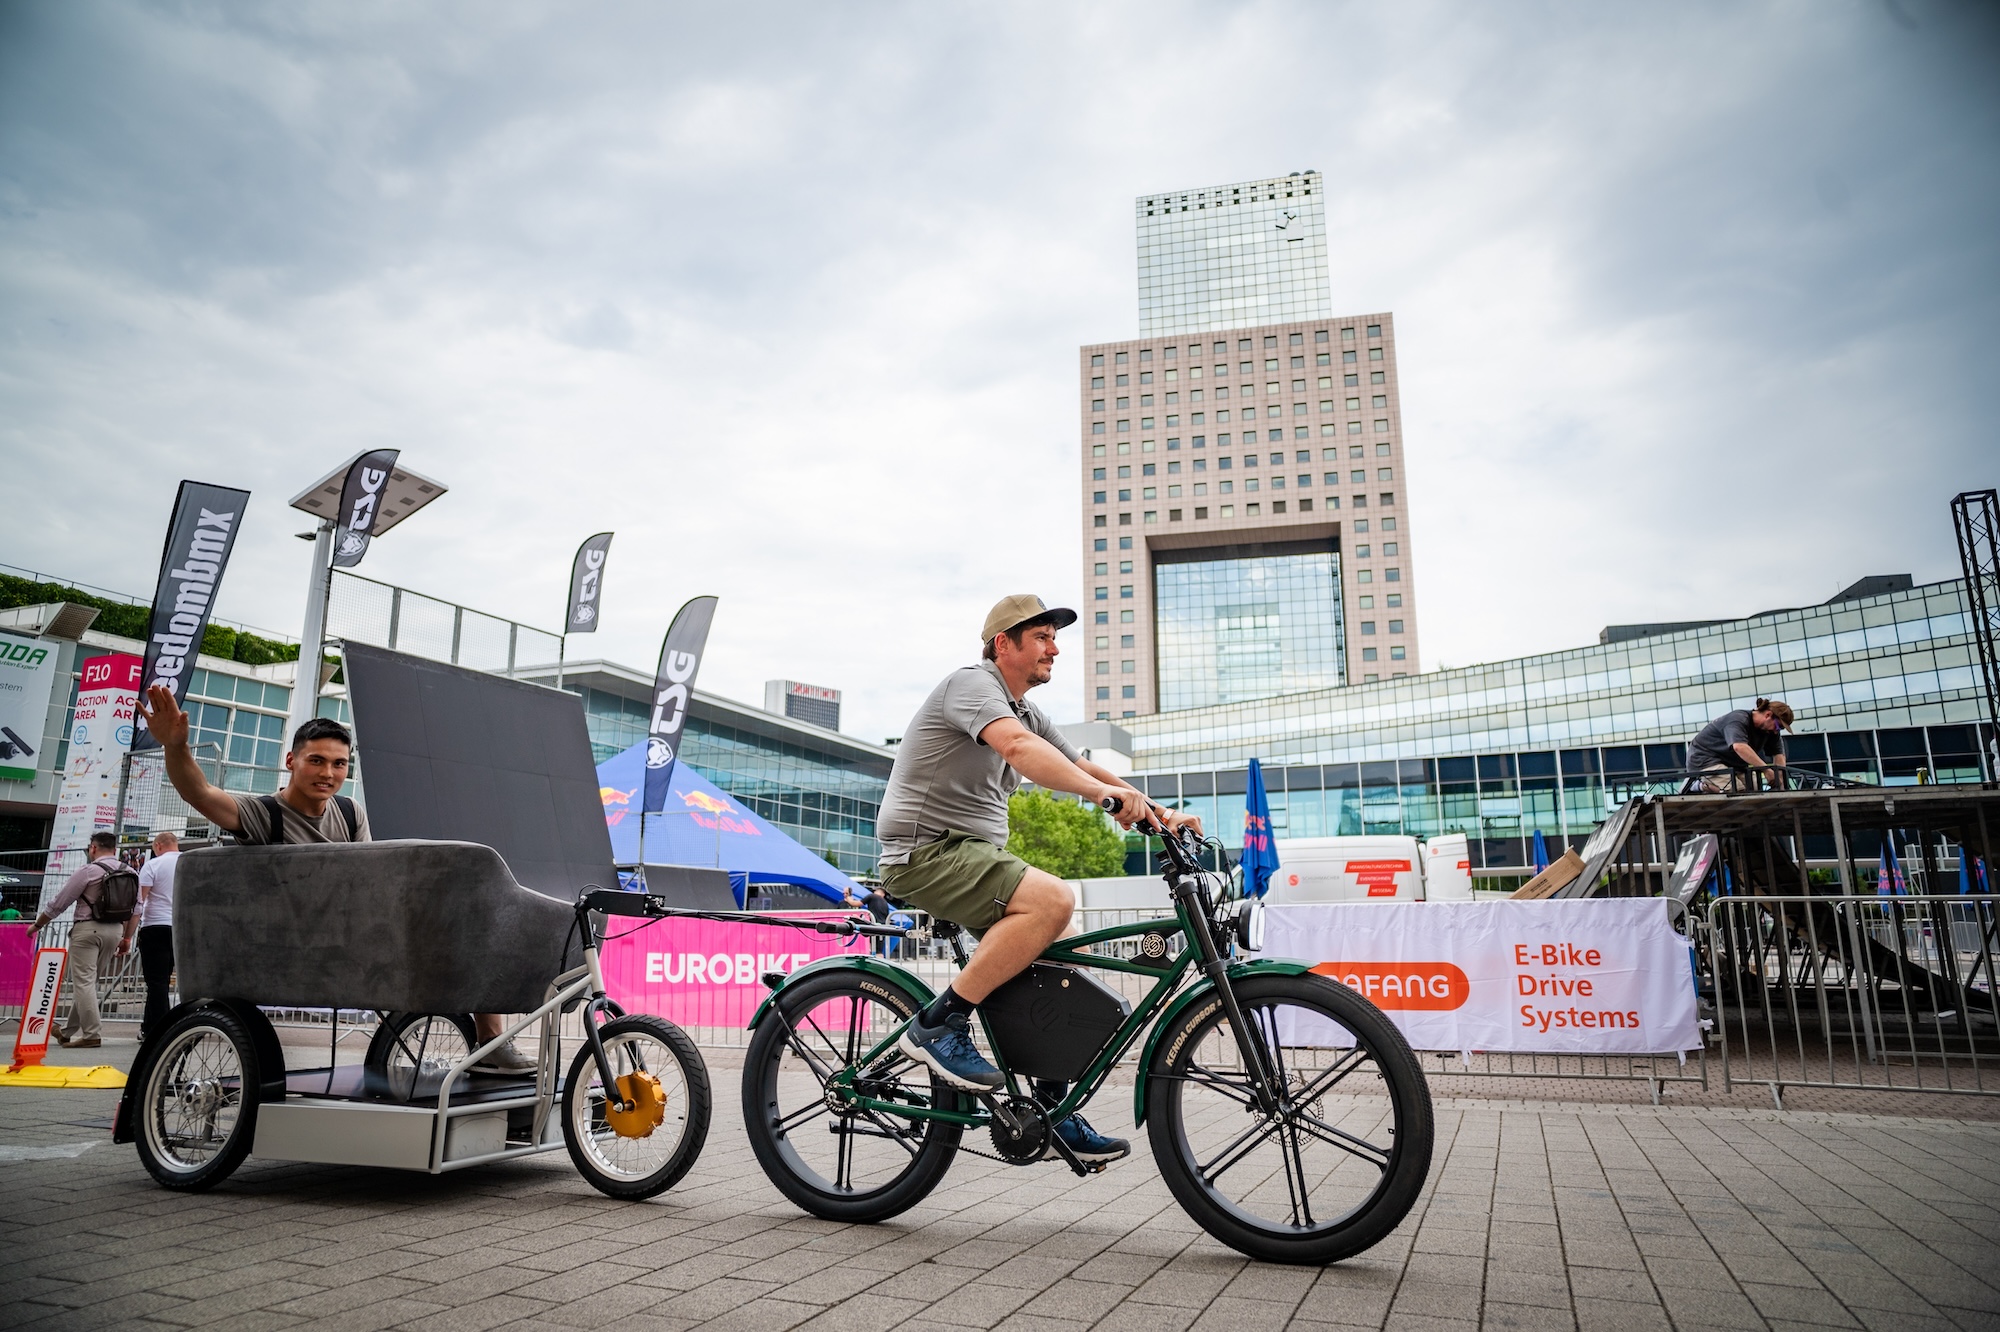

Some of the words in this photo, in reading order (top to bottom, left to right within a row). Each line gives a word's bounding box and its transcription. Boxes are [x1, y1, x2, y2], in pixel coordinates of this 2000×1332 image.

[85, 663, 111, 683] F10
[76, 695, 109, 707] ACTION
[115, 695, 136, 707] AC
[73, 709, 97, 721] AREA
[112, 709, 135, 720] AR
[1514, 943, 1601, 966] E-Bike
[37, 961, 58, 1016] horizont
[860, 981, 889, 999] KENDA
[1517, 973, 1593, 997] Drive
[1520, 1004, 1640, 1033] Systems
[1165, 1031, 1188, 1067] KENDA
[1185, 1003, 1217, 1034] CURSOR
